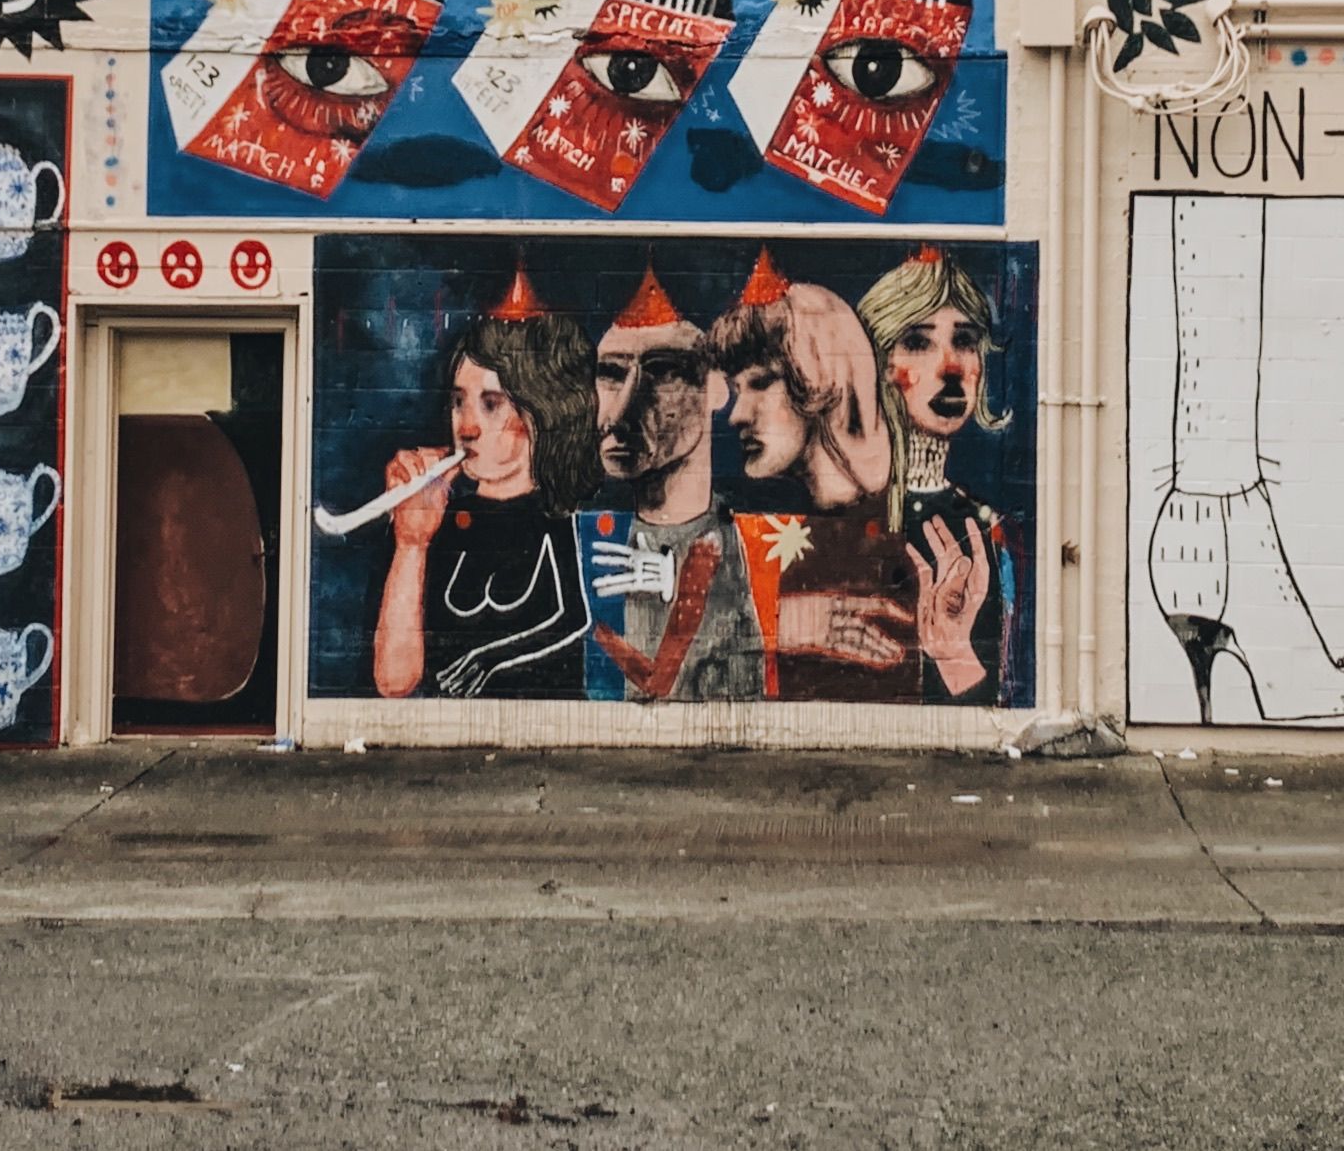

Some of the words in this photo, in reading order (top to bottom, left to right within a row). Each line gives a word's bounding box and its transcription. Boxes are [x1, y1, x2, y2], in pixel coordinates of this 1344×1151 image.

[603, 2, 694, 37] SPECIAL
[184, 53, 221, 88] 123
[203, 133, 296, 179] MATCH
[532, 125, 596, 172] MATCH
